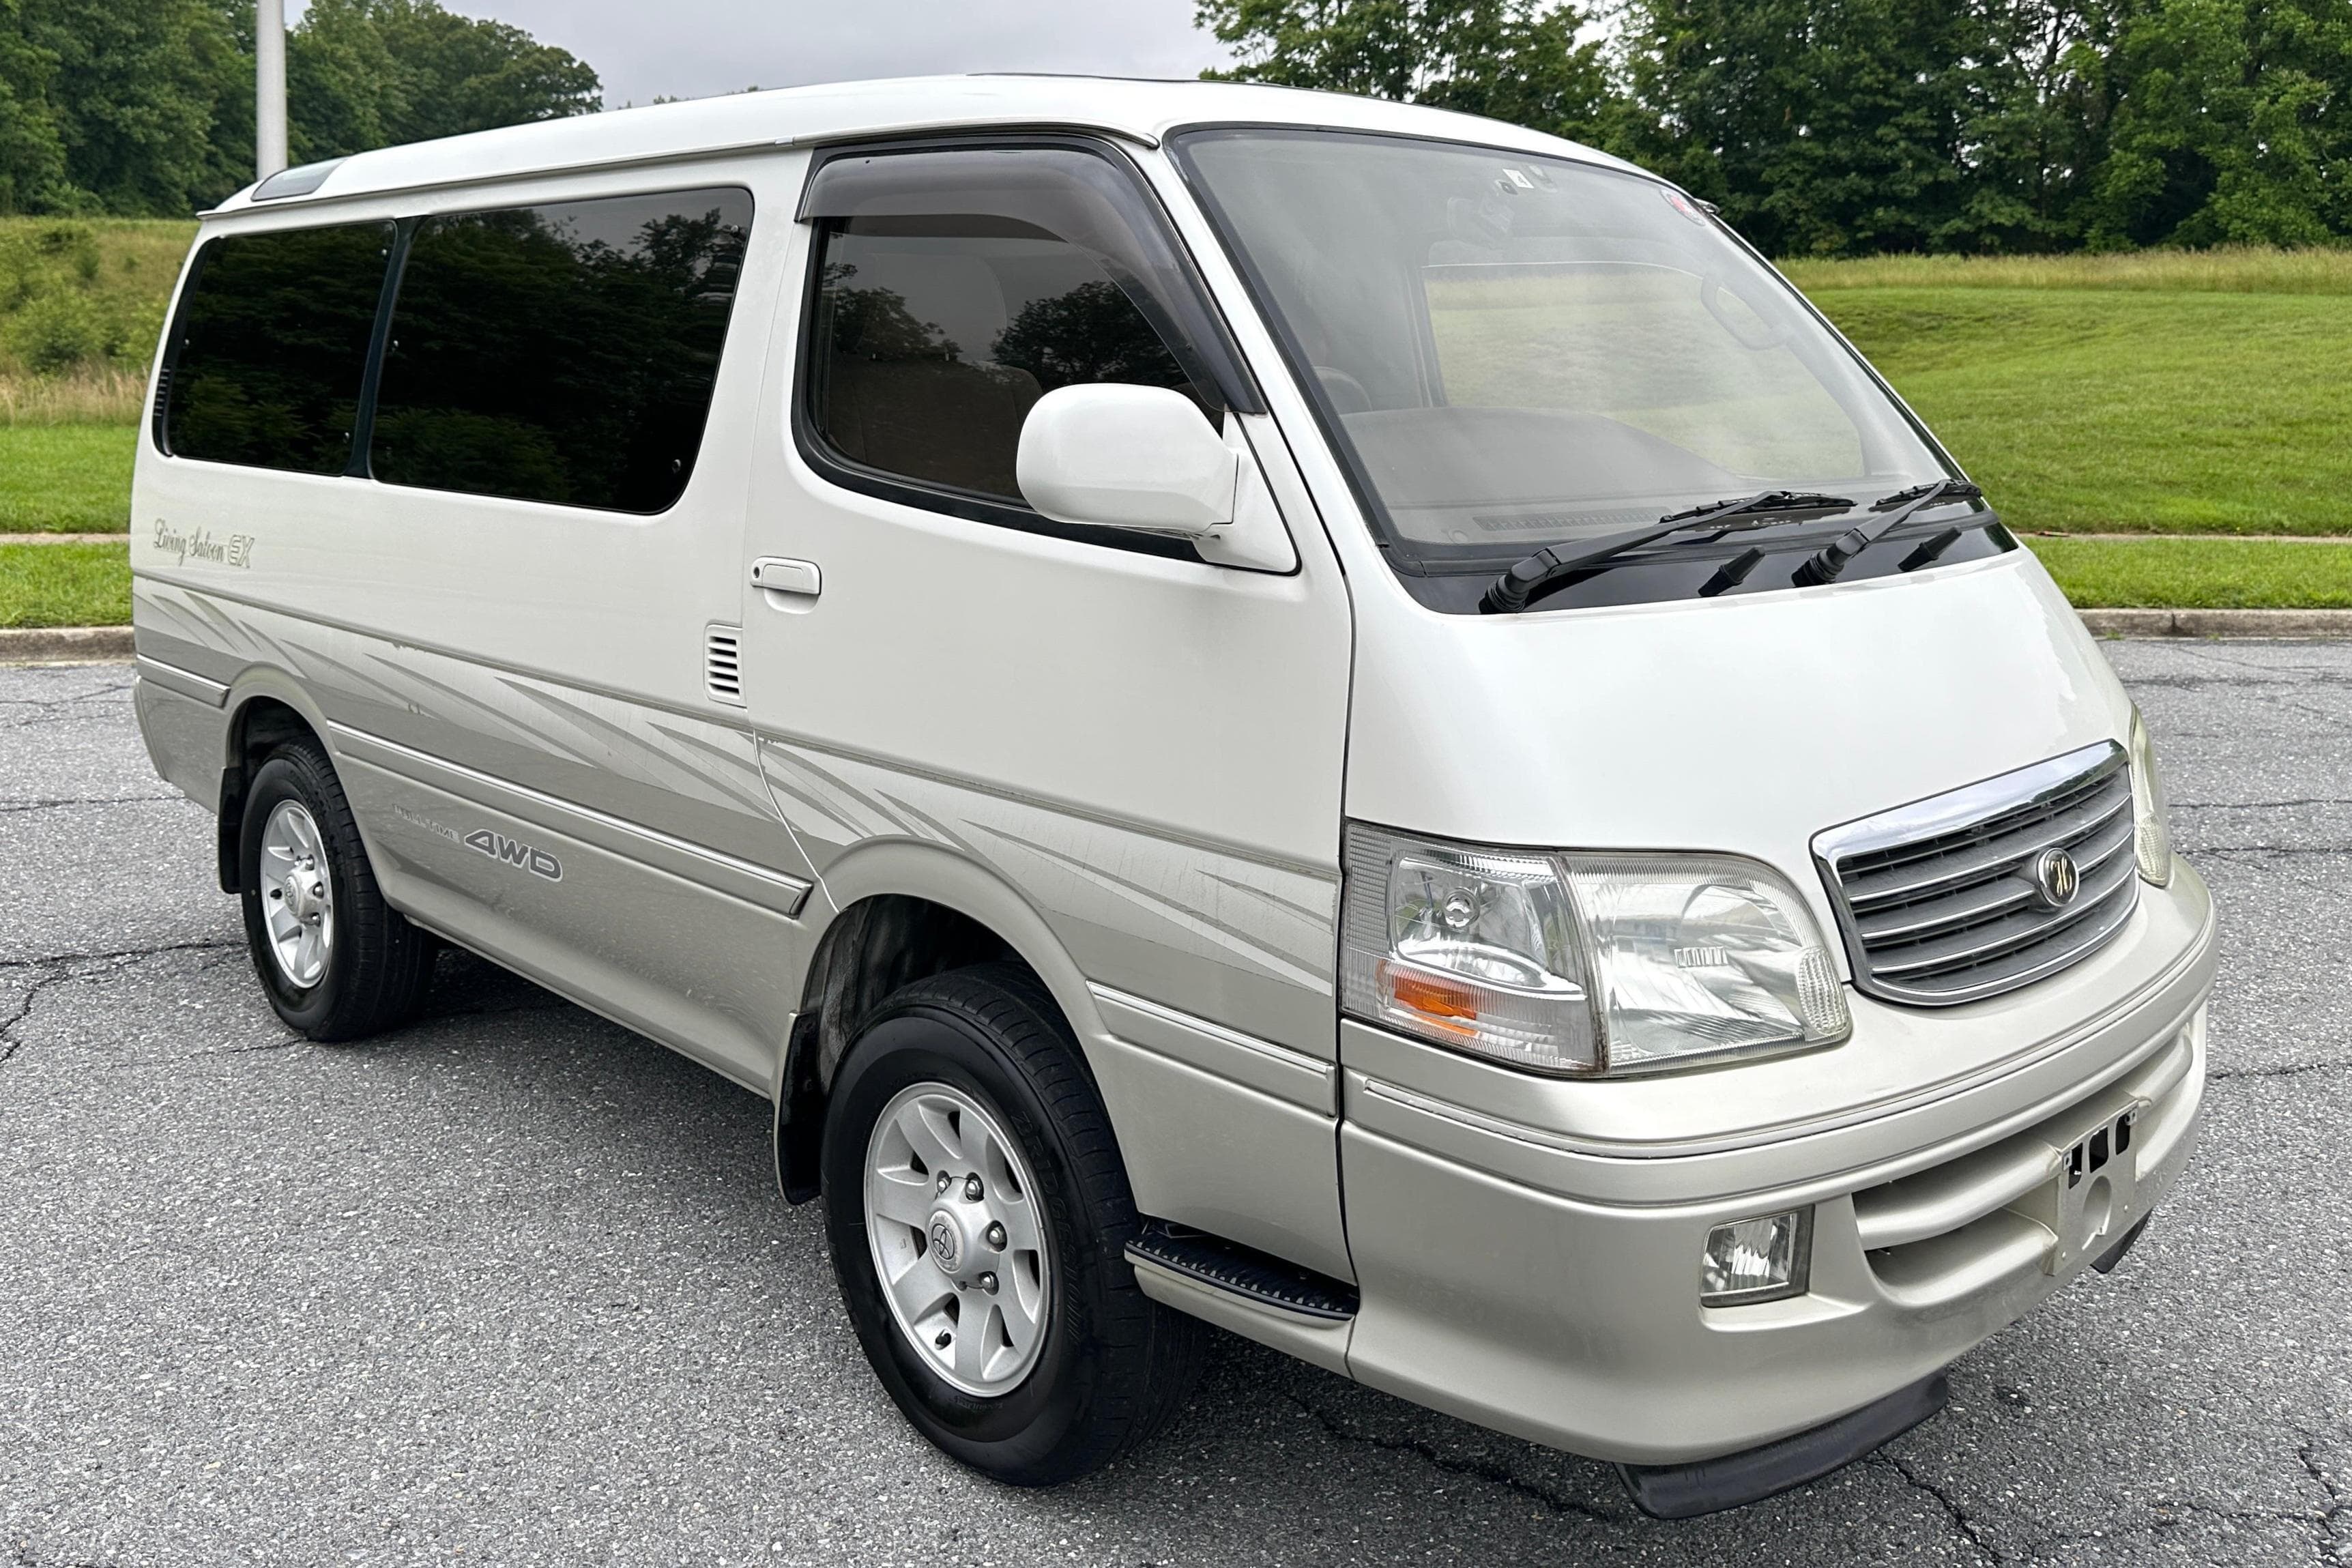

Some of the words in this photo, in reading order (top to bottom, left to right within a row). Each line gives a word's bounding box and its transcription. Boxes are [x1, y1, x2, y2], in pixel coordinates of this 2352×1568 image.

[154, 519, 186, 566] Living
[189, 526, 224, 562] Saloon
[228, 534, 255, 568] EX
[426, 819, 460, 843] TIME
[465, 829, 563, 882] 4WD
